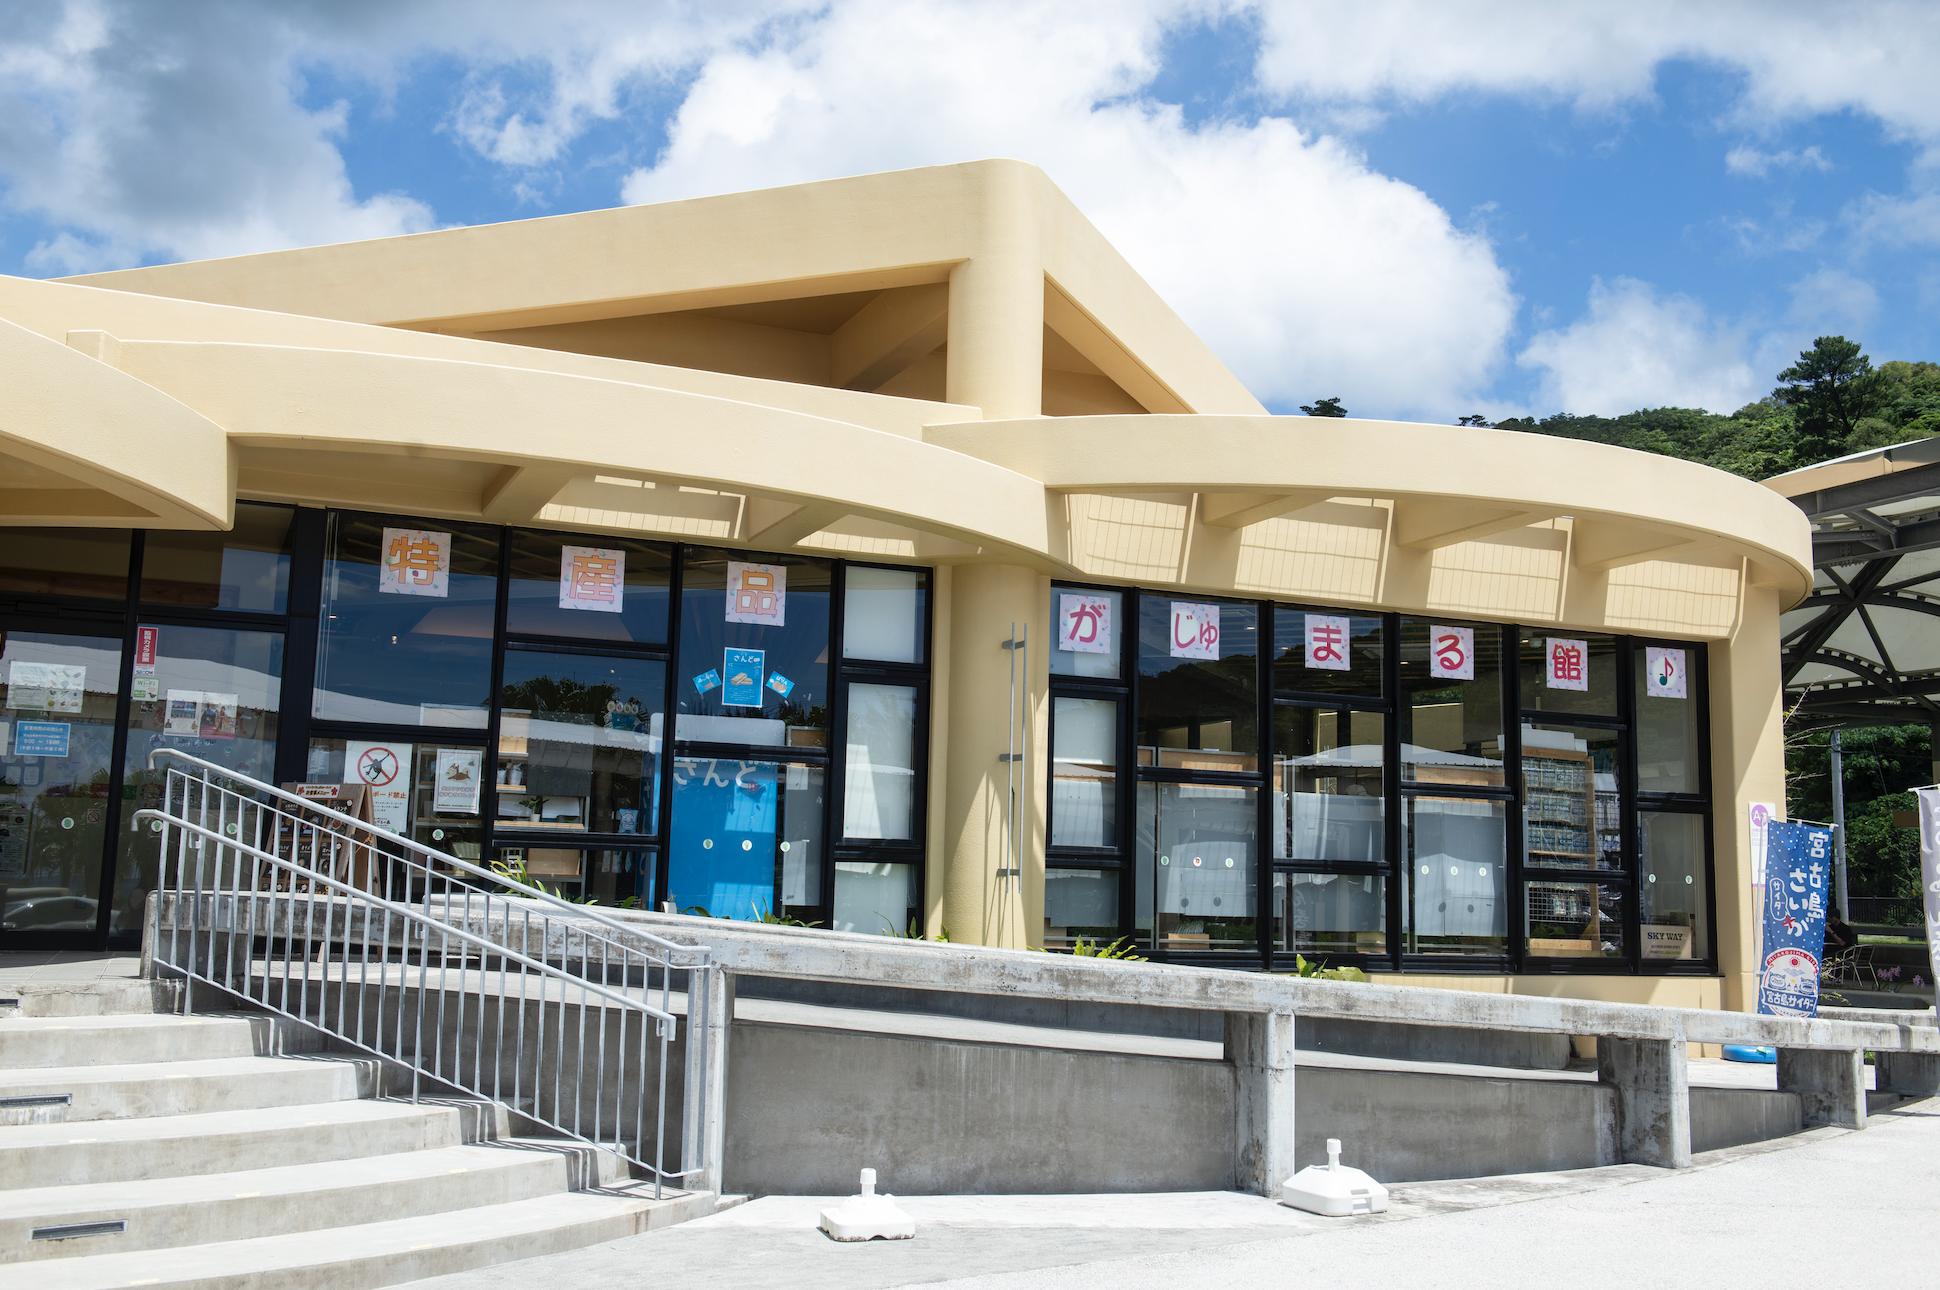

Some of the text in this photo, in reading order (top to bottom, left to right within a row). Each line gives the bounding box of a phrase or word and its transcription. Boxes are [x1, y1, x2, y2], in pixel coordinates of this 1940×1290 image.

[388, 535, 778, 615] 特 産 品
[1068, 603, 1583, 682] が じゅ ま る 館
[1773, 881, 1782, 916] サイダー
[1808, 831, 1829, 919] 宮古島
[1647, 932, 1683, 941] SKY WAY
[1766, 990, 1815, 1009] 宮古島サイダー
